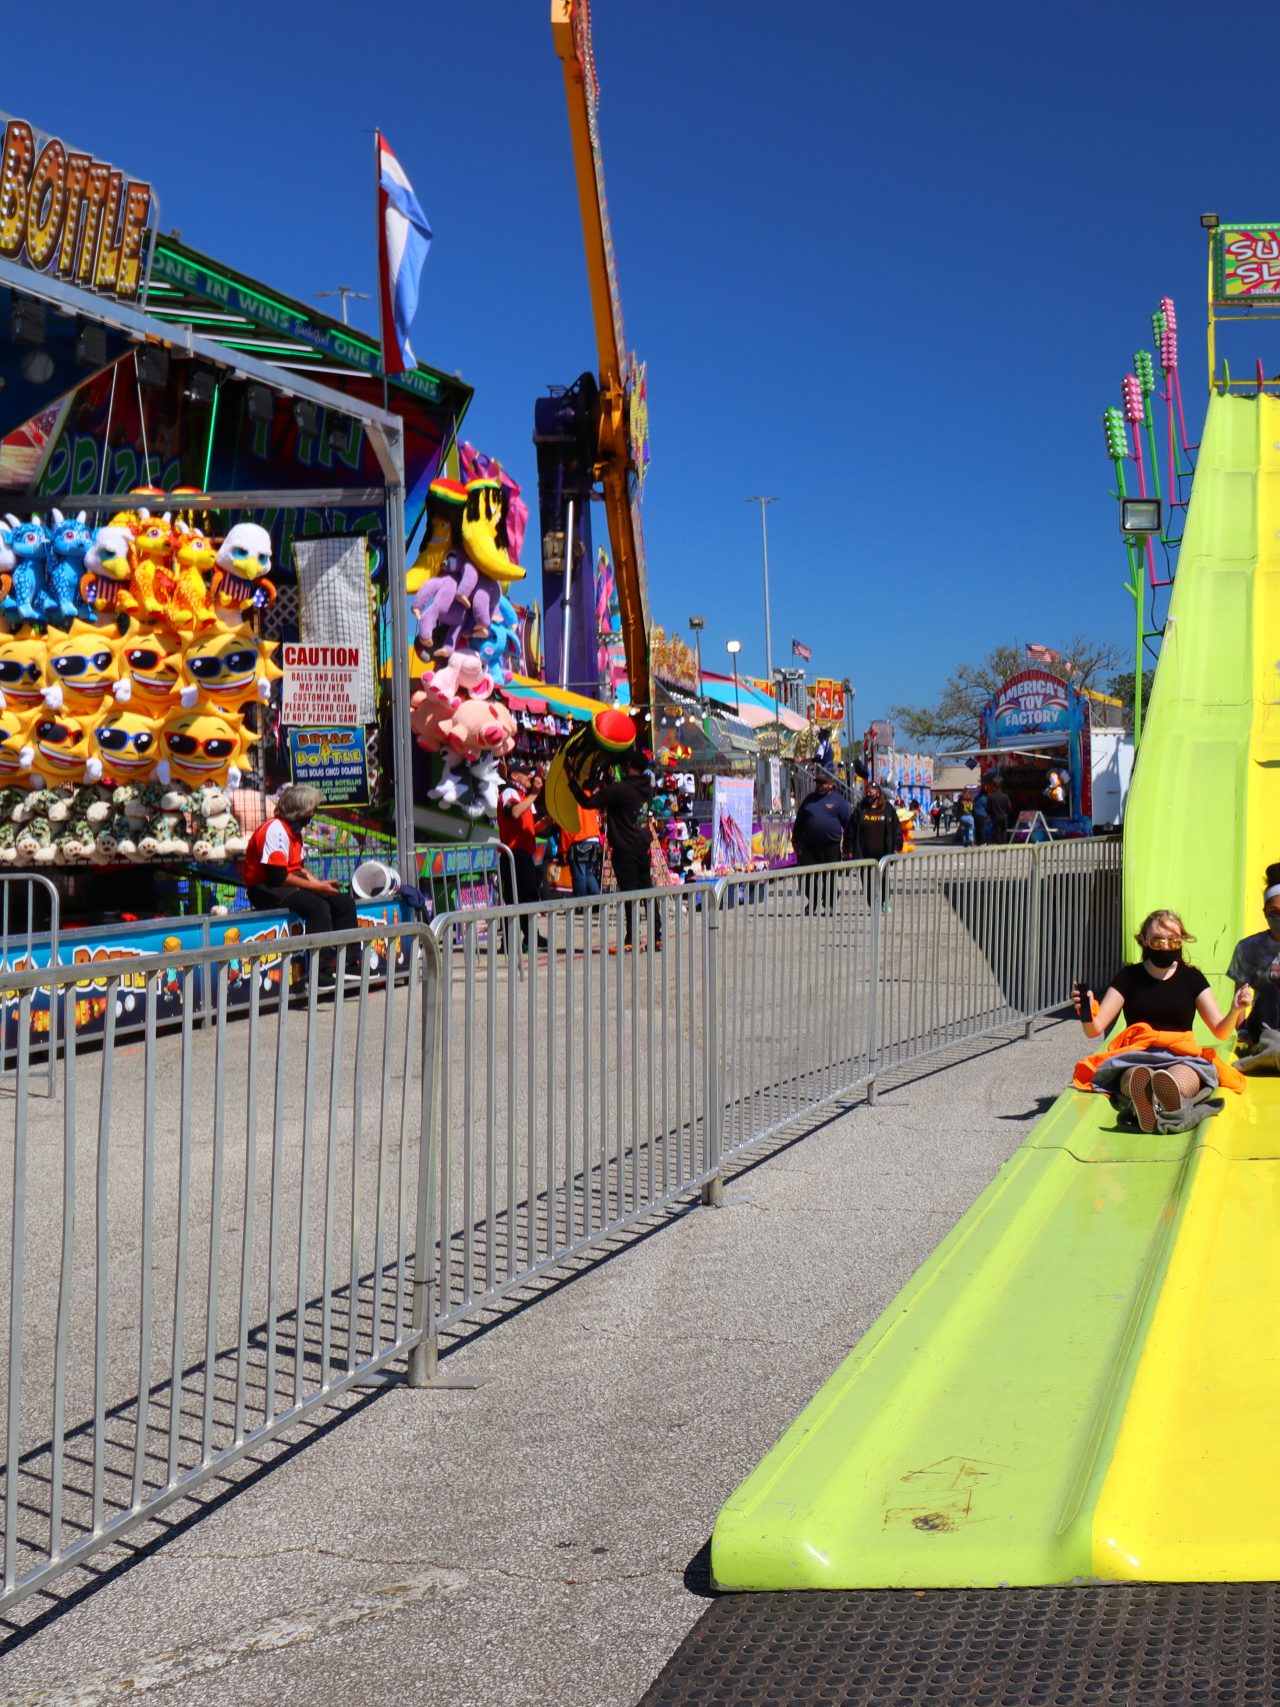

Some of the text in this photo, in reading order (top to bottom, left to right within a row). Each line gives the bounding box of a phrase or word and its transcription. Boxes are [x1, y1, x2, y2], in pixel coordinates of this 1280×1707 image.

[0, 119, 151, 304] BOTTLE
[150, 254, 197, 285] ONE
[206, 277, 229, 301] IN
[238, 292, 290, 329] WINS
[334, 340, 371, 367] ONE
[400, 370, 438, 396] WINS
[285, 646, 359, 667] CAUTION
[292, 672, 352, 683] BALLS AND GLASS
[299, 683, 345, 693] MAY FLY INTO
[1000, 681, 1065, 705] AMERICA'S
[293, 693, 350, 703] CUSTOMER AREA
[1019, 695, 1044, 710] TOY
[285, 703, 357, 713] PLEASE STAND CLEAR
[284, 713, 357, 723] IF NOT PLAYING GAME
[1006, 710, 1059, 726] FACTORY
[297, 732, 353, 747] BREAK
[295, 748, 362, 767] BOTTLE
[296, 766, 363, 778] TRES BOLAS CINCO DOLARES
